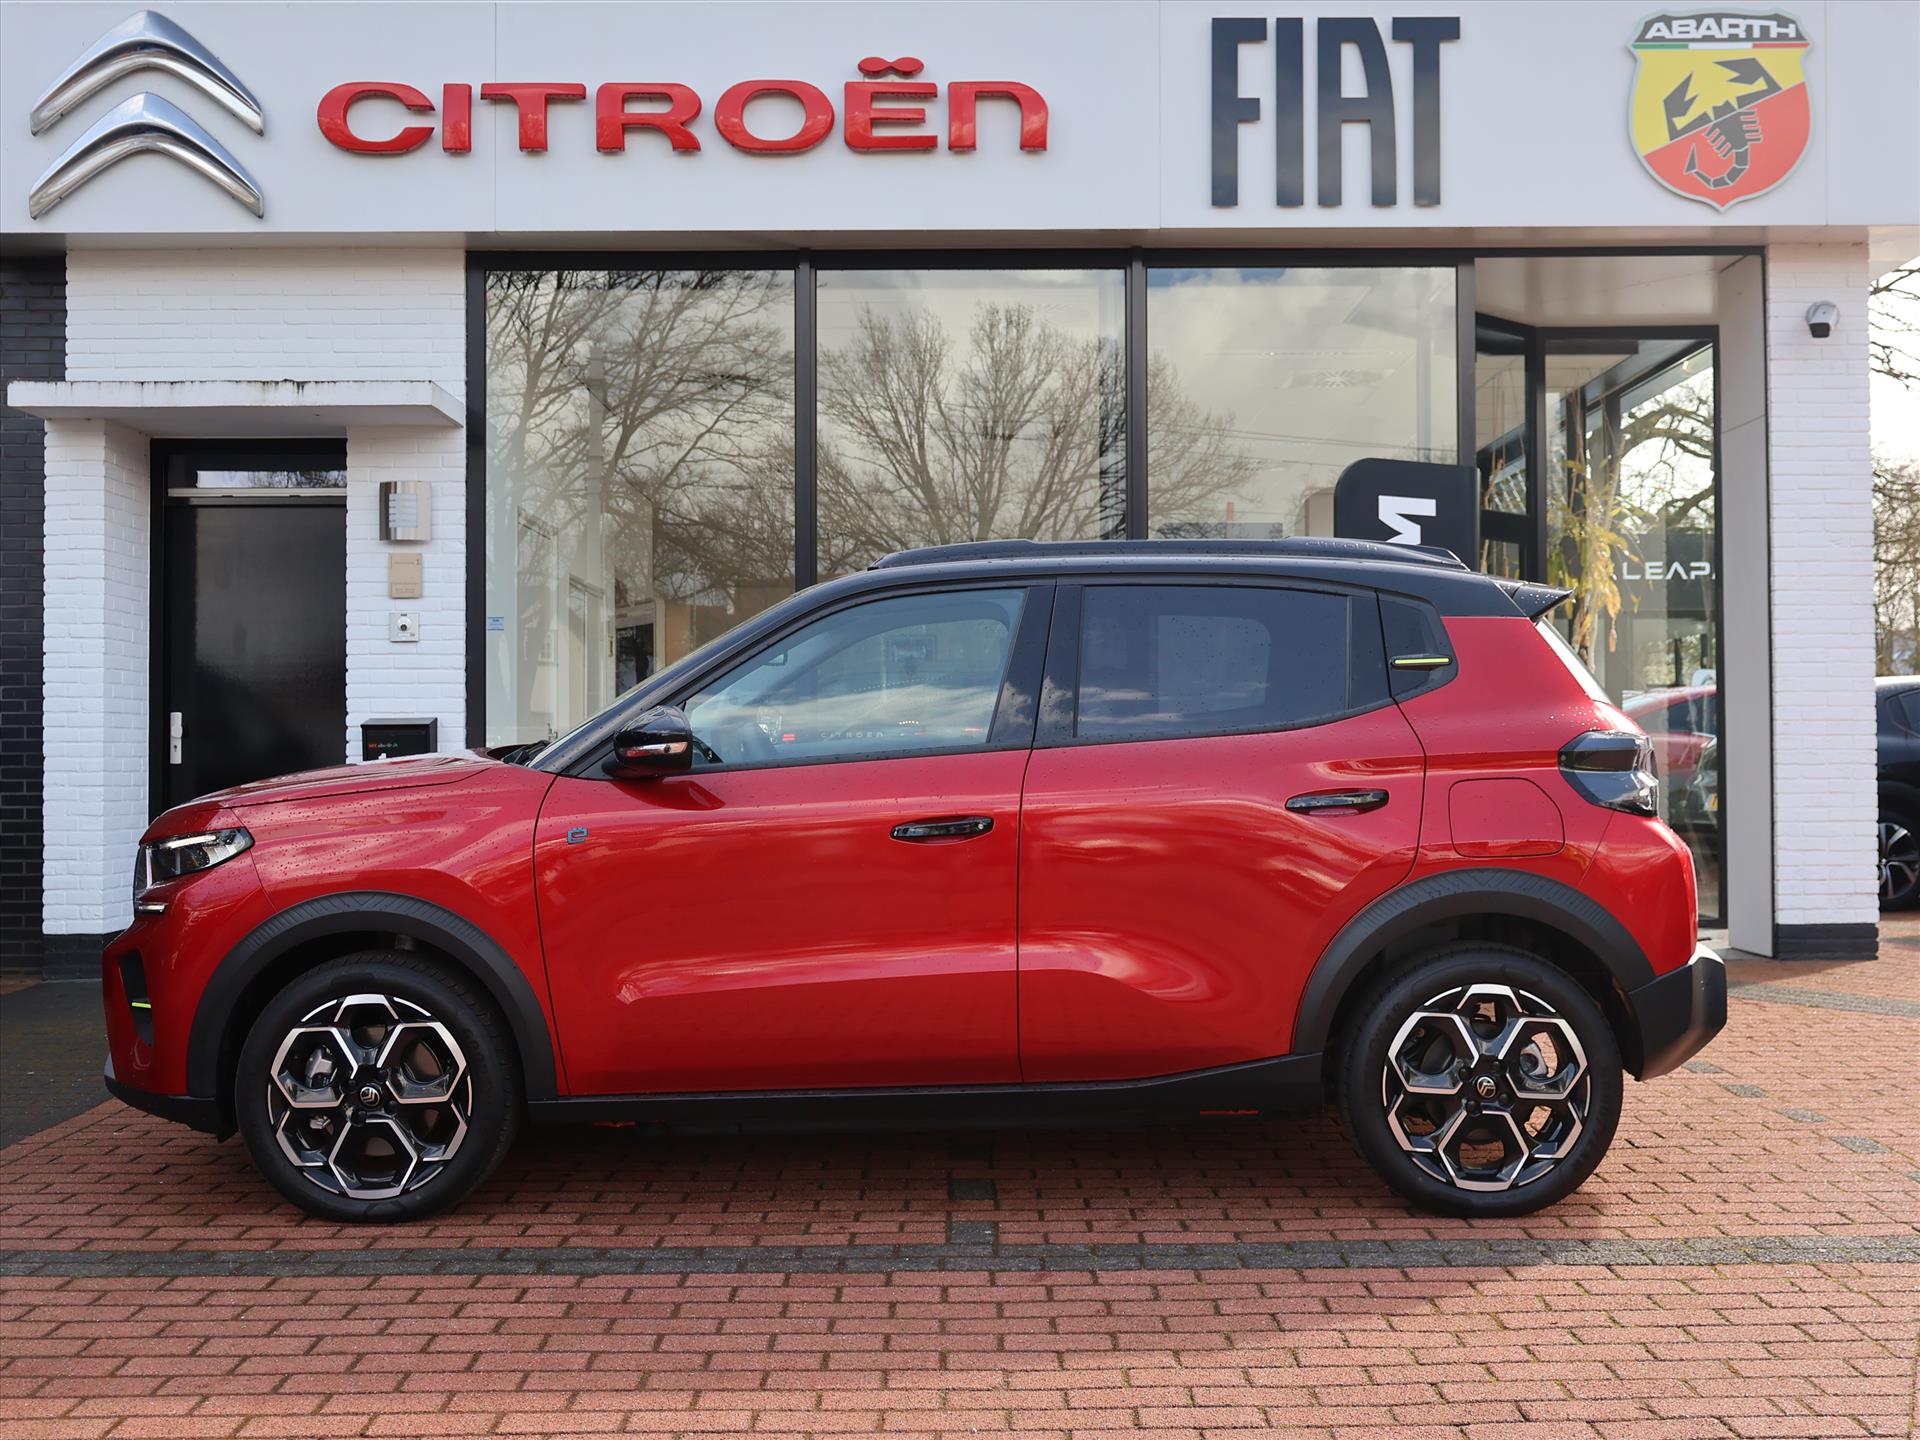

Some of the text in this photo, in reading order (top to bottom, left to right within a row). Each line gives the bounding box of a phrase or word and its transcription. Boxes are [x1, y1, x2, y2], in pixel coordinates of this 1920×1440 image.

[1644, 17, 1797, 40] ABARTH
[1211, 16, 1461, 207] FIAT
[1622, 561, 1716, 580] LEAP
